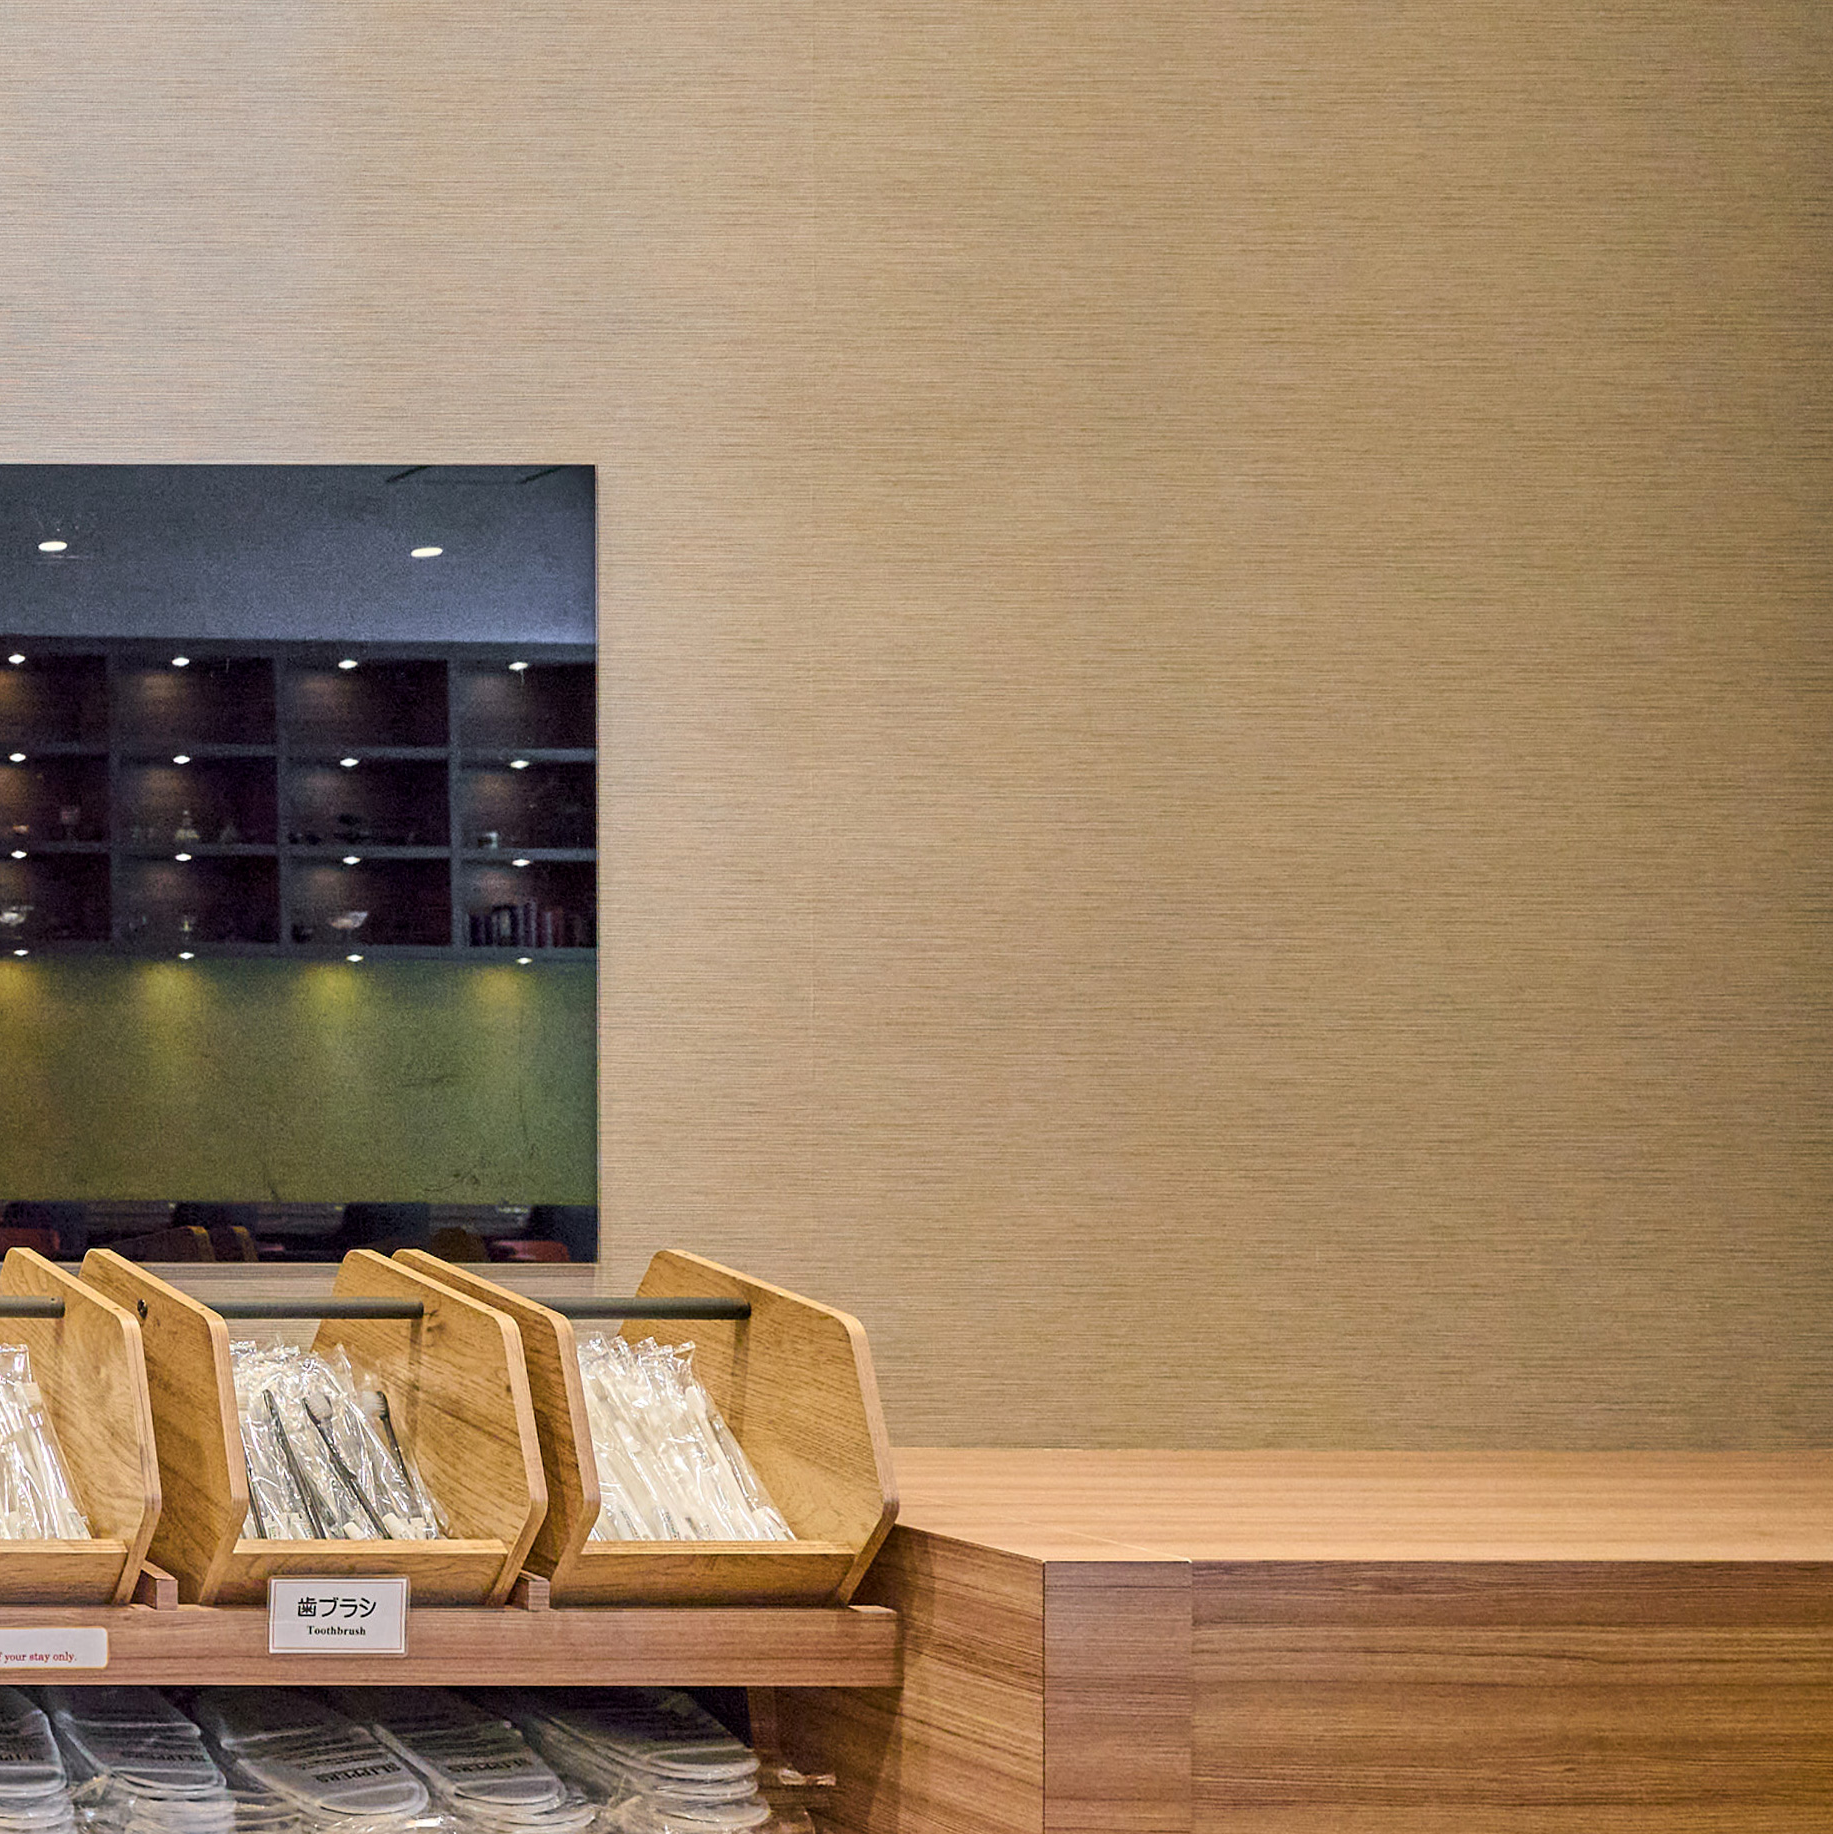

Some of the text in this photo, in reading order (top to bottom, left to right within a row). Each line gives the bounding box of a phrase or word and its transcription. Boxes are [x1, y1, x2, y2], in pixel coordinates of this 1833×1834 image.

[297, 1596, 377, 1619] 歯ブラシ
[306, 1625, 366, 1636] Toothbrush
[3, 1653, 28, 1664] your
[28, 1652, 51, 1664] stay
[52, 1650, 78, 1664] only.
